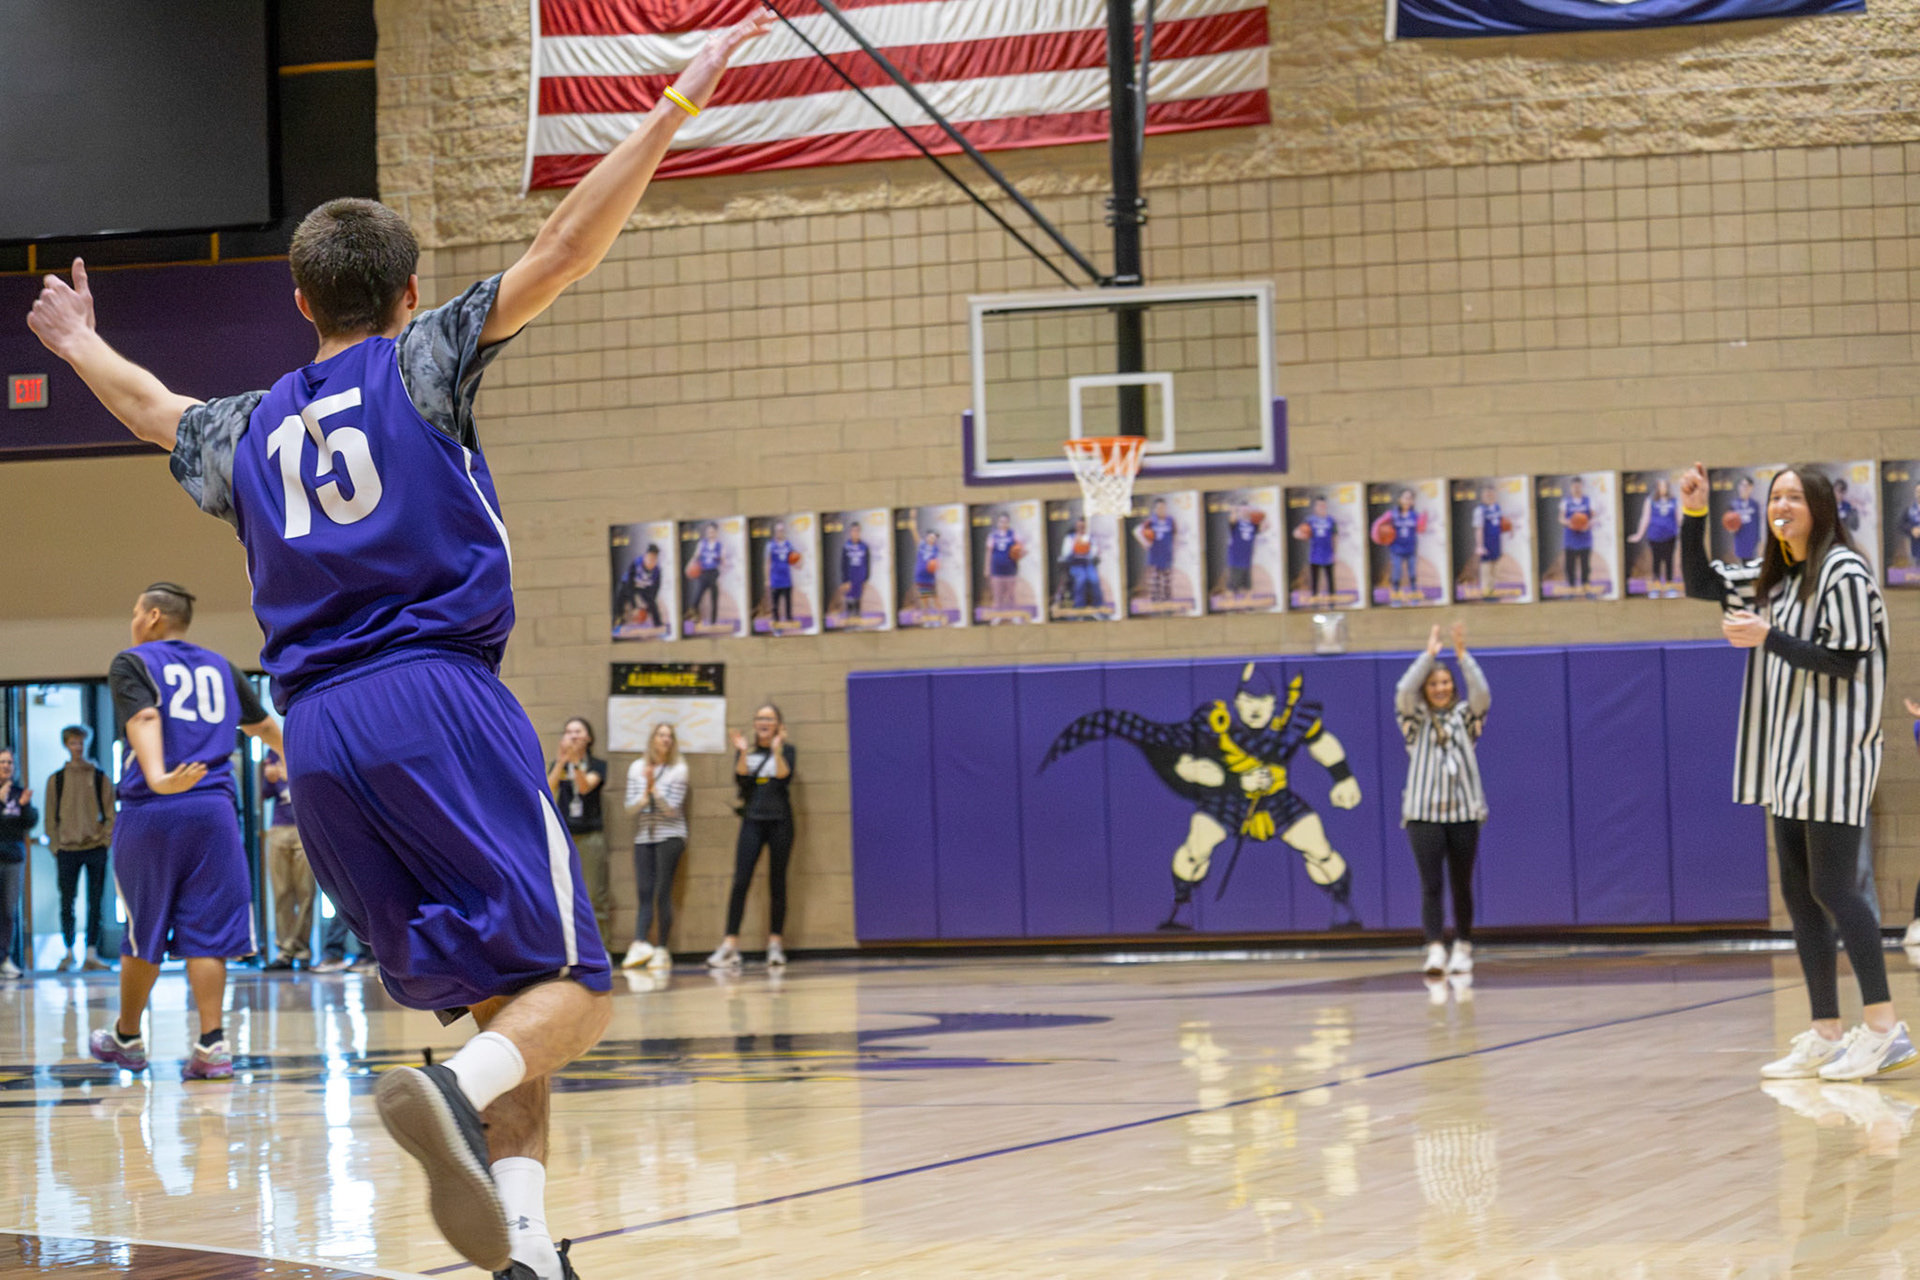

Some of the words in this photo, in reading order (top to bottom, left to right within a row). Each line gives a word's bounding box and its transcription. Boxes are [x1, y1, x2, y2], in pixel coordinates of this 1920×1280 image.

[15, 378, 42, 403] EXIT
[267, 387, 383, 539] 15
[163, 664, 226, 724] 20
